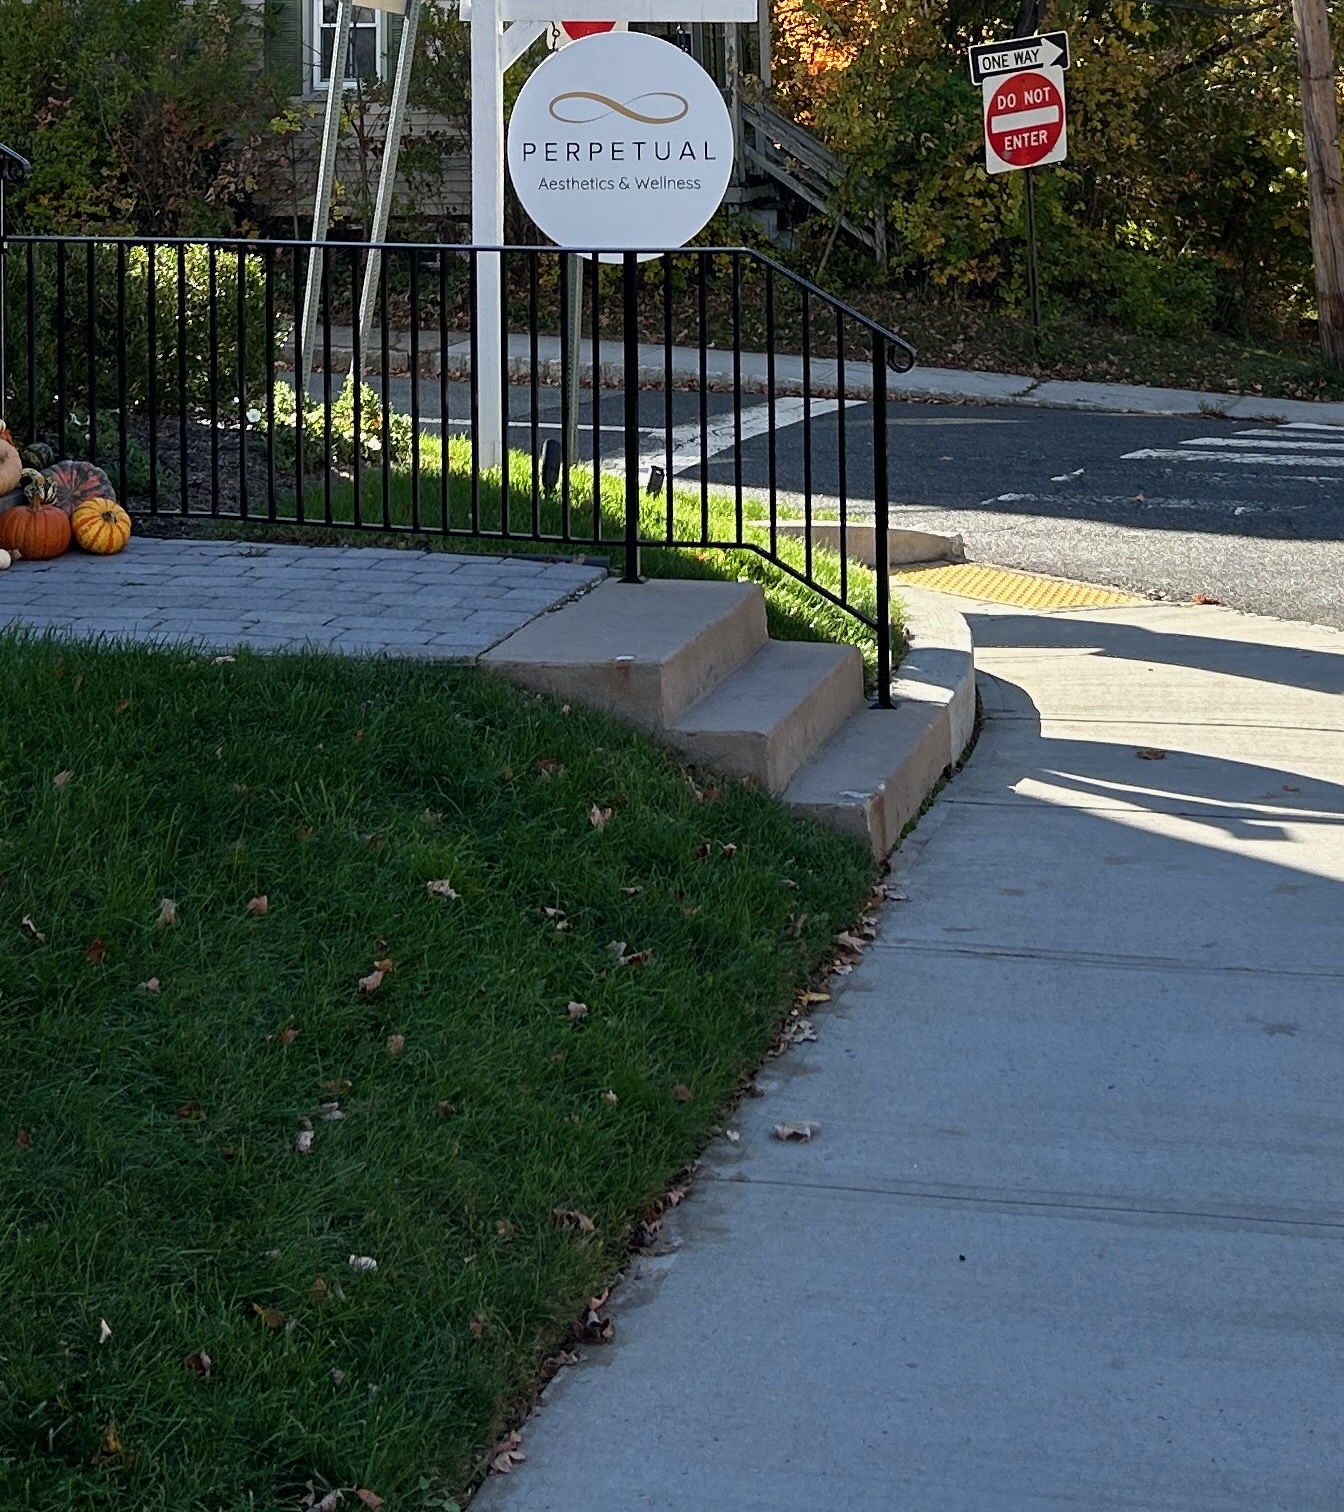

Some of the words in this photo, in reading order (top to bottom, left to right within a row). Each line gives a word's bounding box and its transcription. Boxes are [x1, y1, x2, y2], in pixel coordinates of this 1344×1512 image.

[982, 53, 1009, 71] ONE
[1013, 48, 1040, 65] WAY
[997, 93, 1016, 110] DO
[1023, 87, 1051, 105] NOT
[522, 140, 717, 162] PERPETUAL
[1004, 130, 1048, 151] ENTER
[538, 175, 615, 191] Aesthetics
[618, 176, 630, 190] &
[634, 175, 702, 190] Wellness
